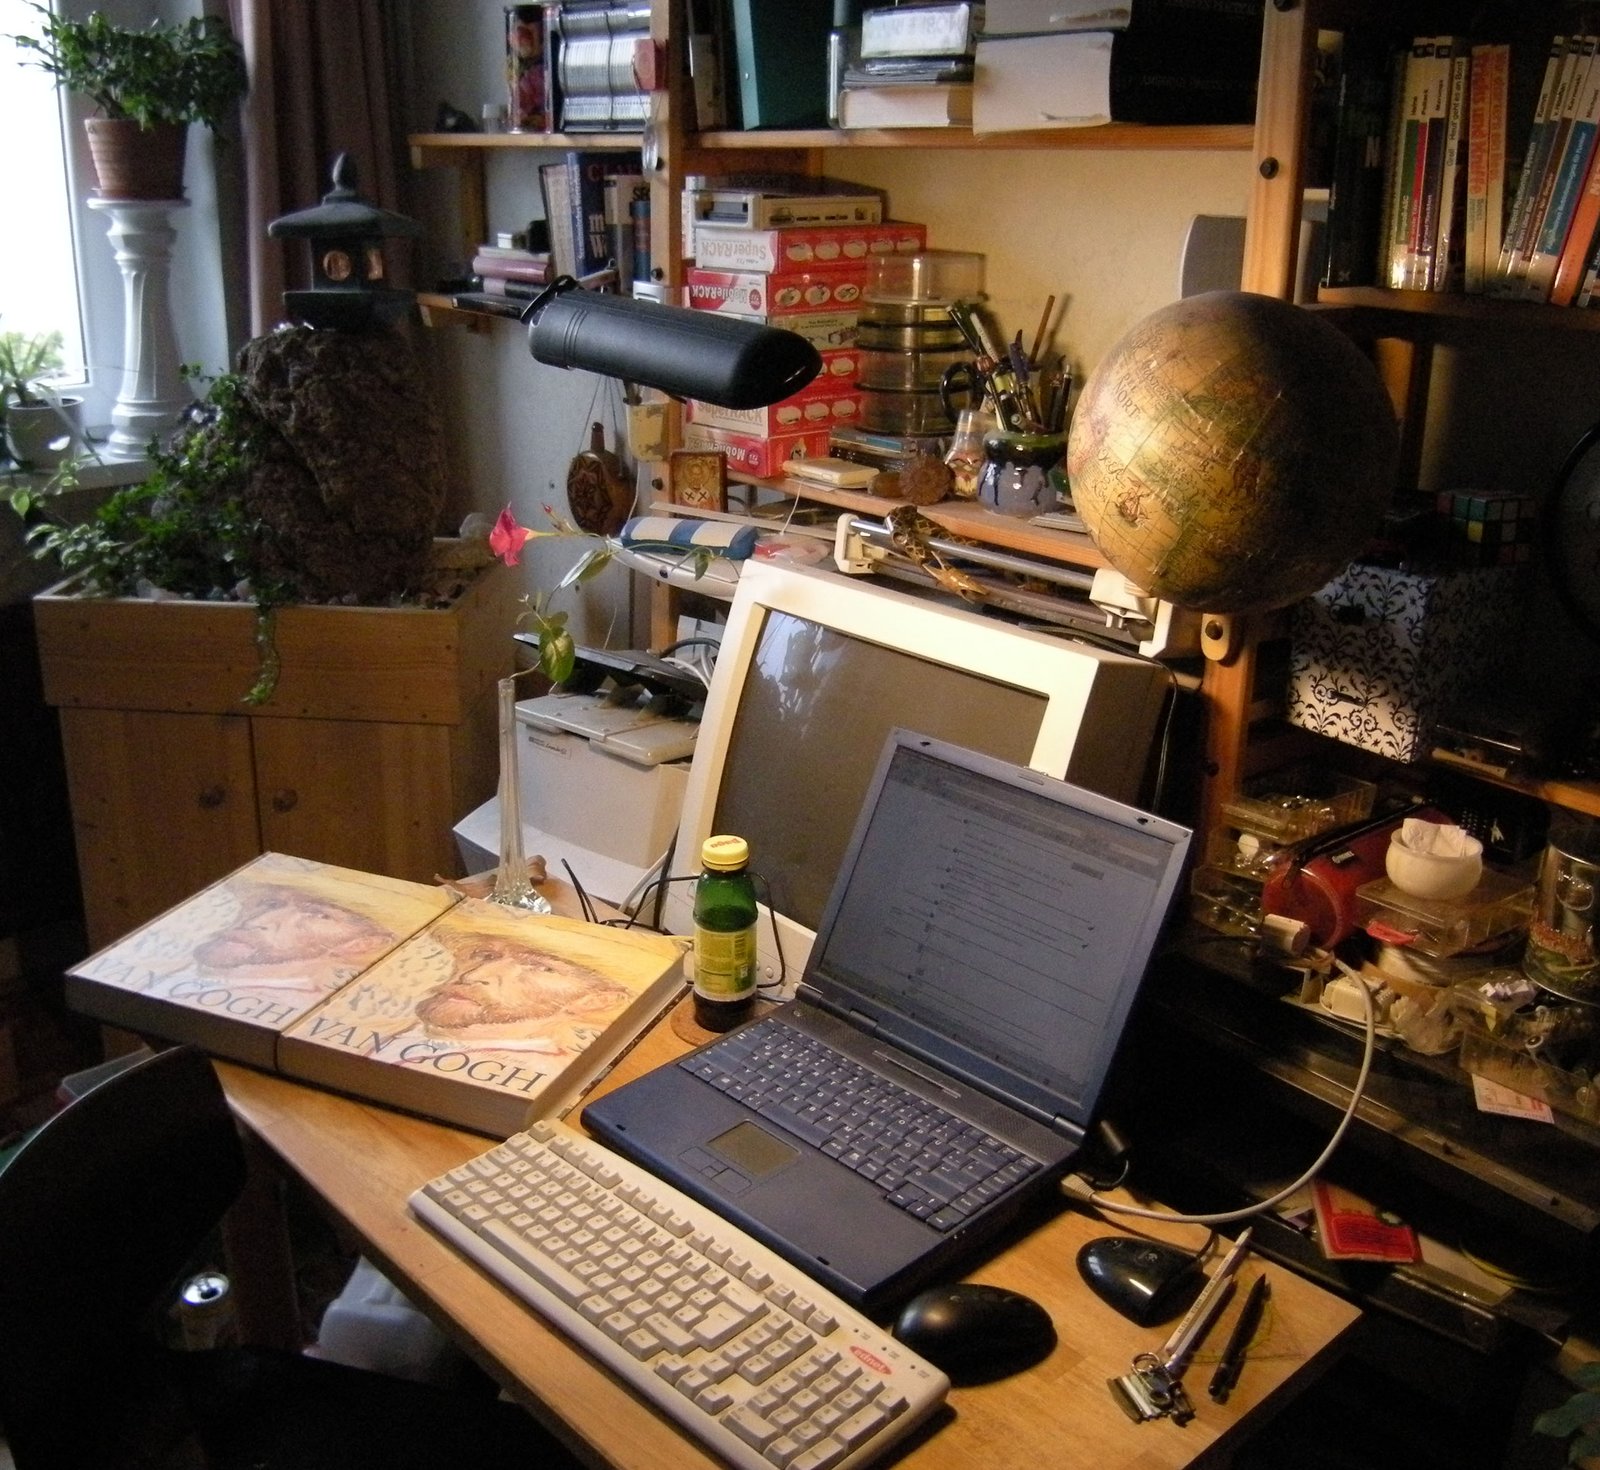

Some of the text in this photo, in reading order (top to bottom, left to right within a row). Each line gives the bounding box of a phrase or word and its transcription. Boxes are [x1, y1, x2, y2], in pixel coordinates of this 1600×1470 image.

[701, 240, 767, 259] SuperRACK
[92, 958, 299, 1025] VAN GOGH
[309, 1017, 398, 1054] VAN
[400, 1043, 547, 1093] GOGH
